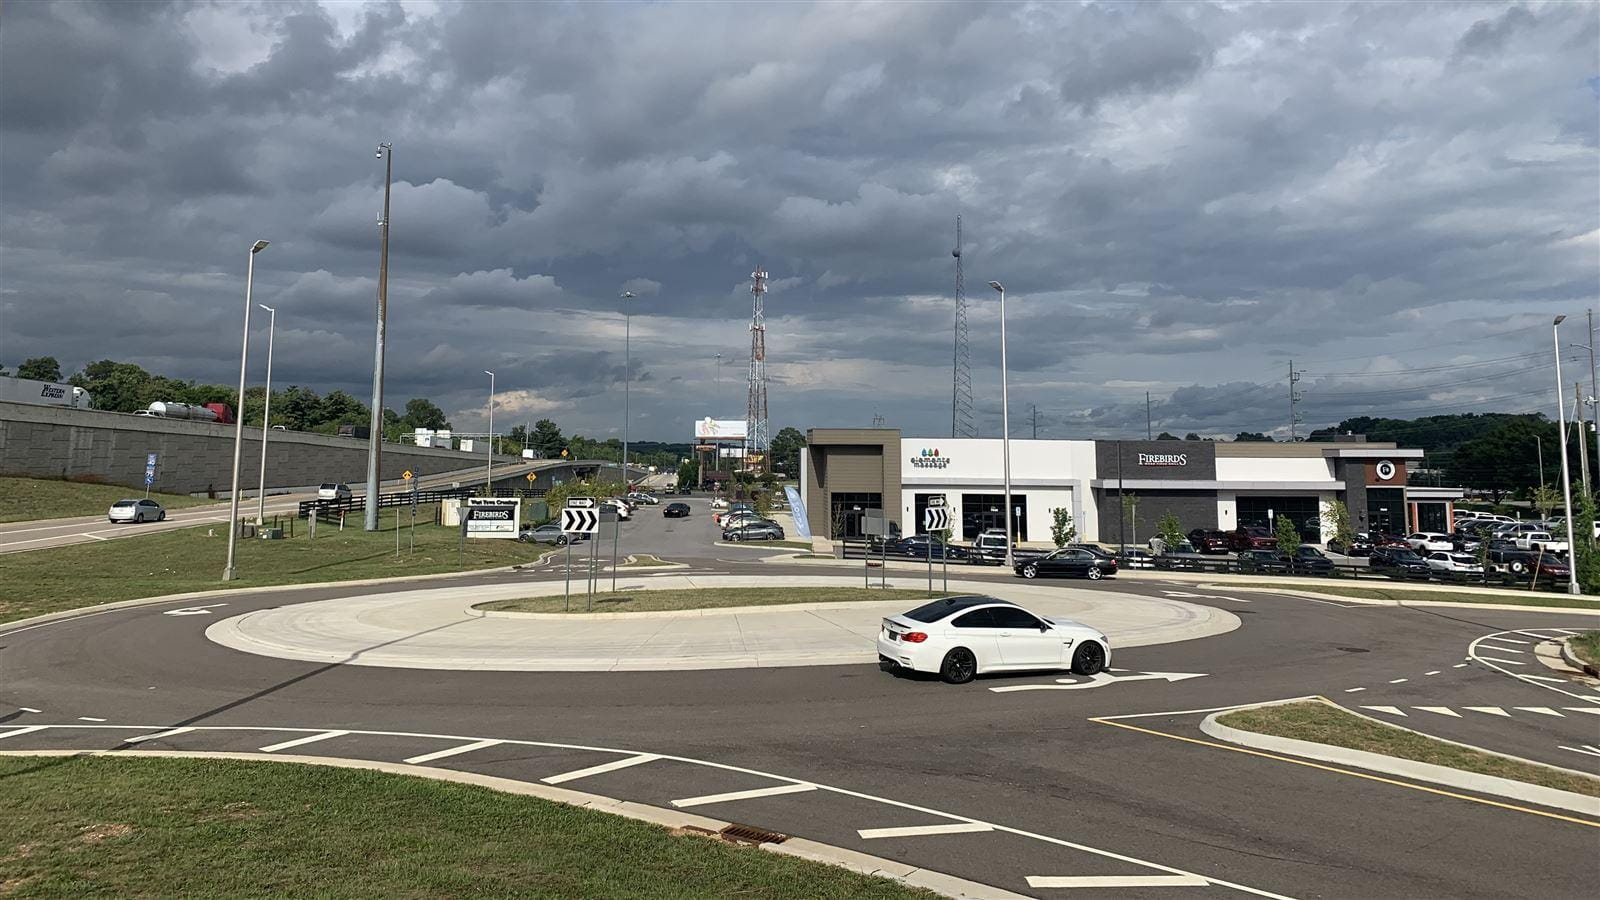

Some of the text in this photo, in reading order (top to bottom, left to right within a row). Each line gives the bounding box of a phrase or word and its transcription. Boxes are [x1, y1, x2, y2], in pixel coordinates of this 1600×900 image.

[42, 384, 65, 394] WESTERN
[1138, 453, 1187, 466] FIREBIRDS
[473, 510, 509, 520] FIREBIRDS
